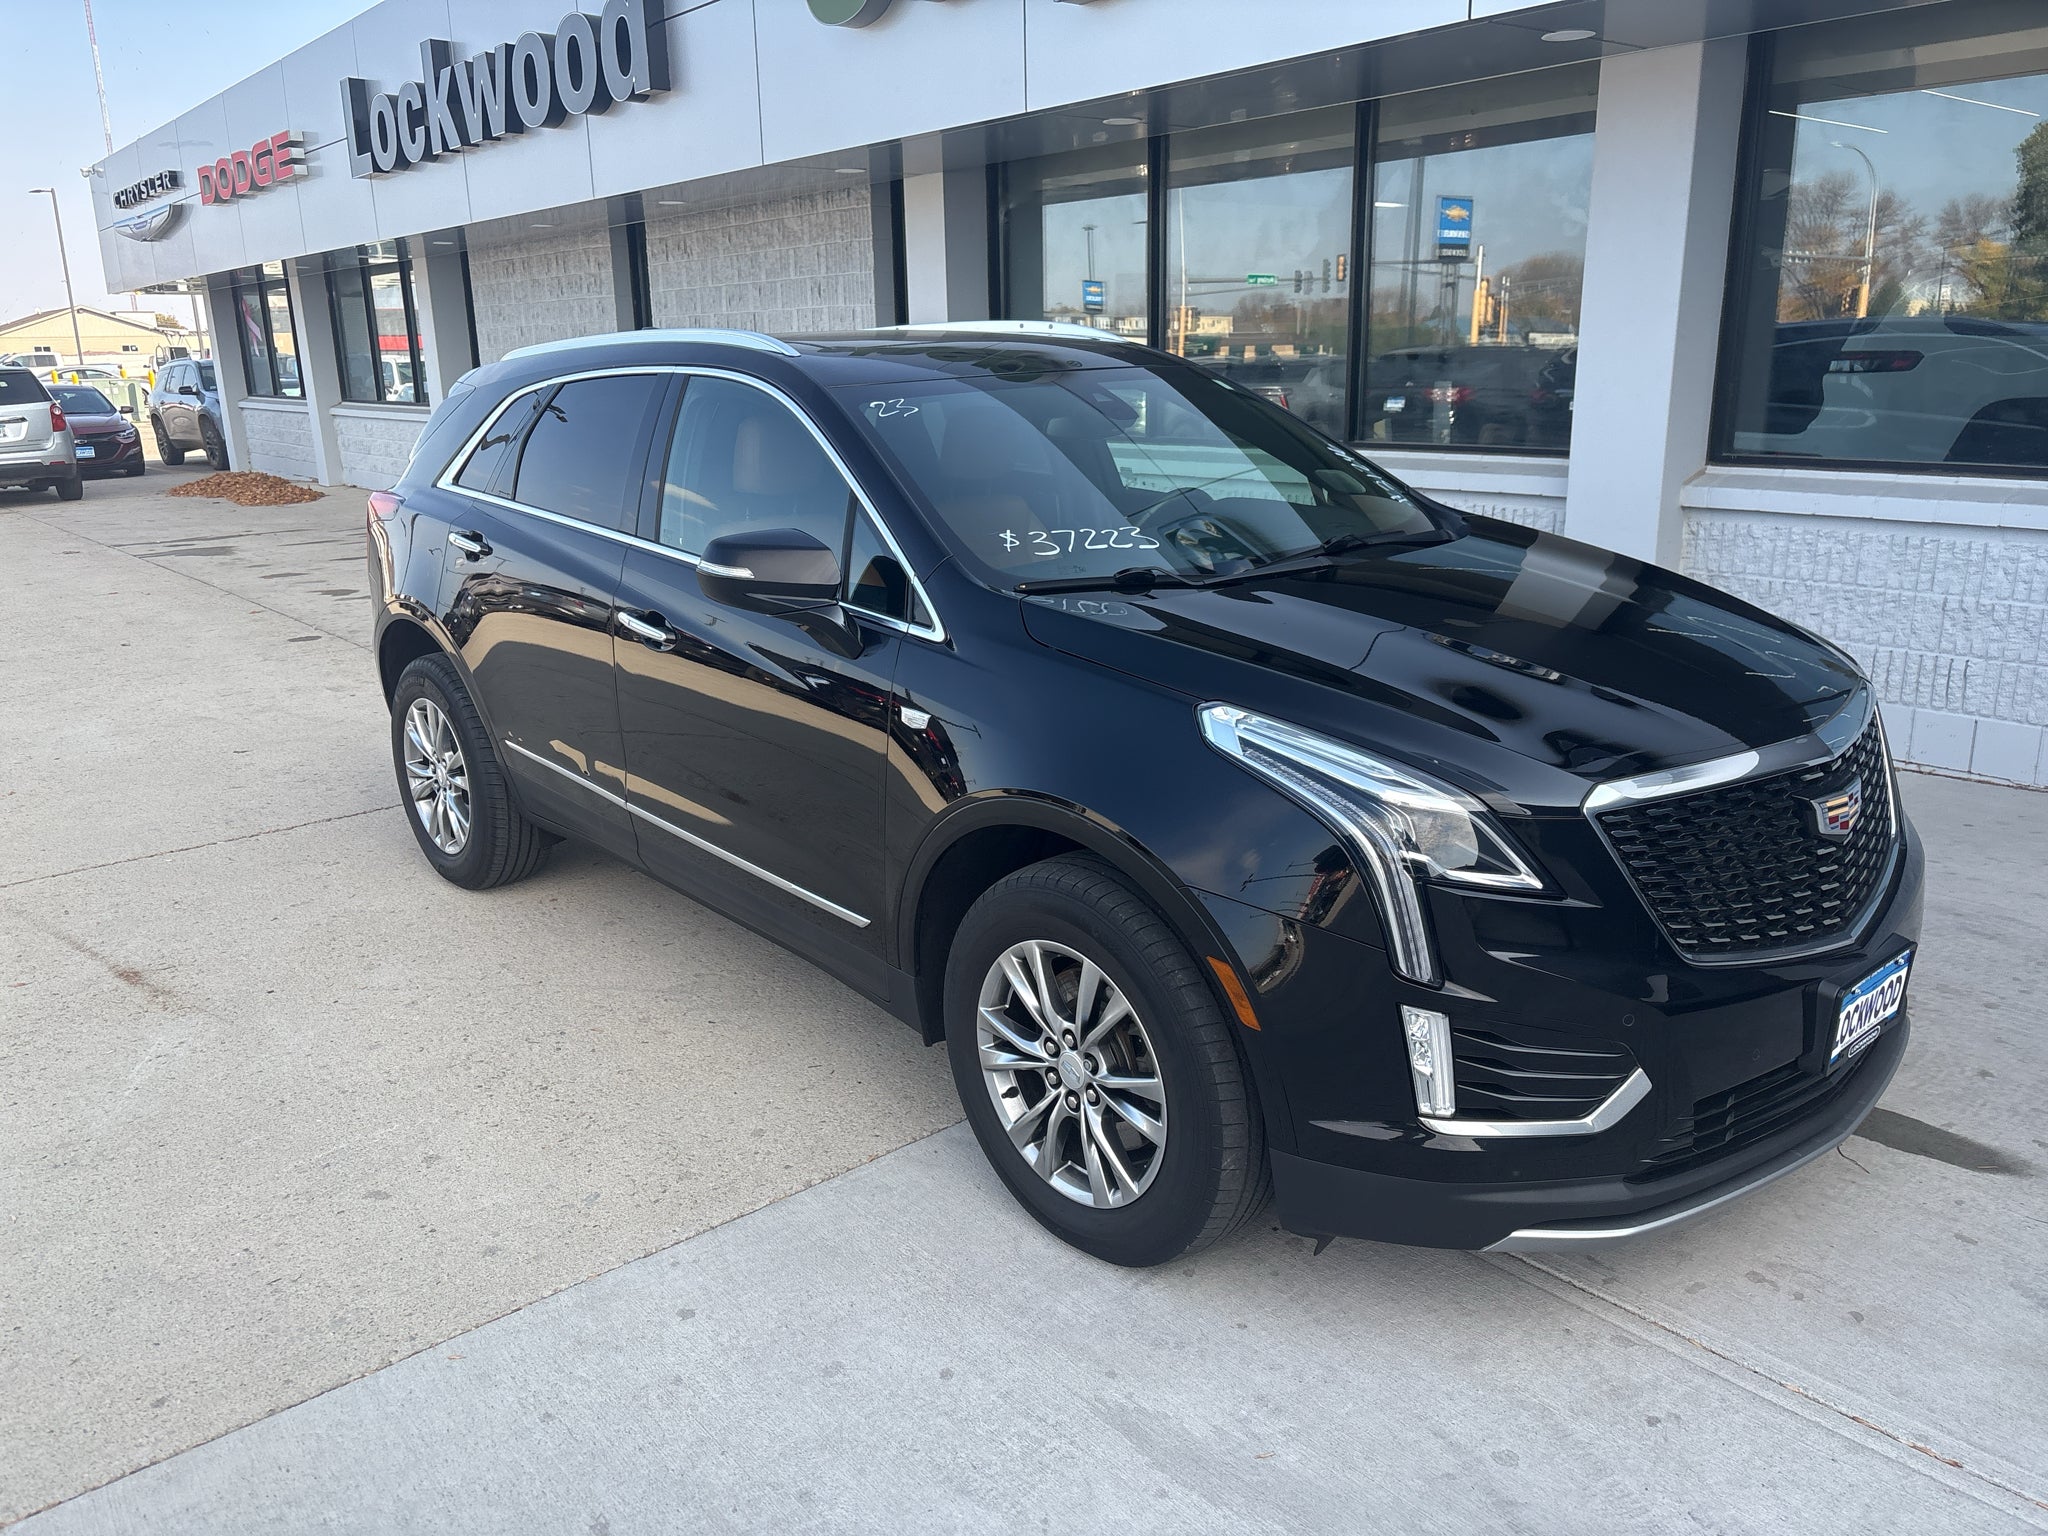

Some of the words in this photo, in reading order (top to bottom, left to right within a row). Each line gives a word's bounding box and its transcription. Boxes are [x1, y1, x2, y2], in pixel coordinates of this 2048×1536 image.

[112, 169, 178, 209] CHRYSLER
[197, 130, 304, 206] DODGE
[869, 398, 919, 418] 23
[1836, 974, 1903, 1045] OCKWOOD
